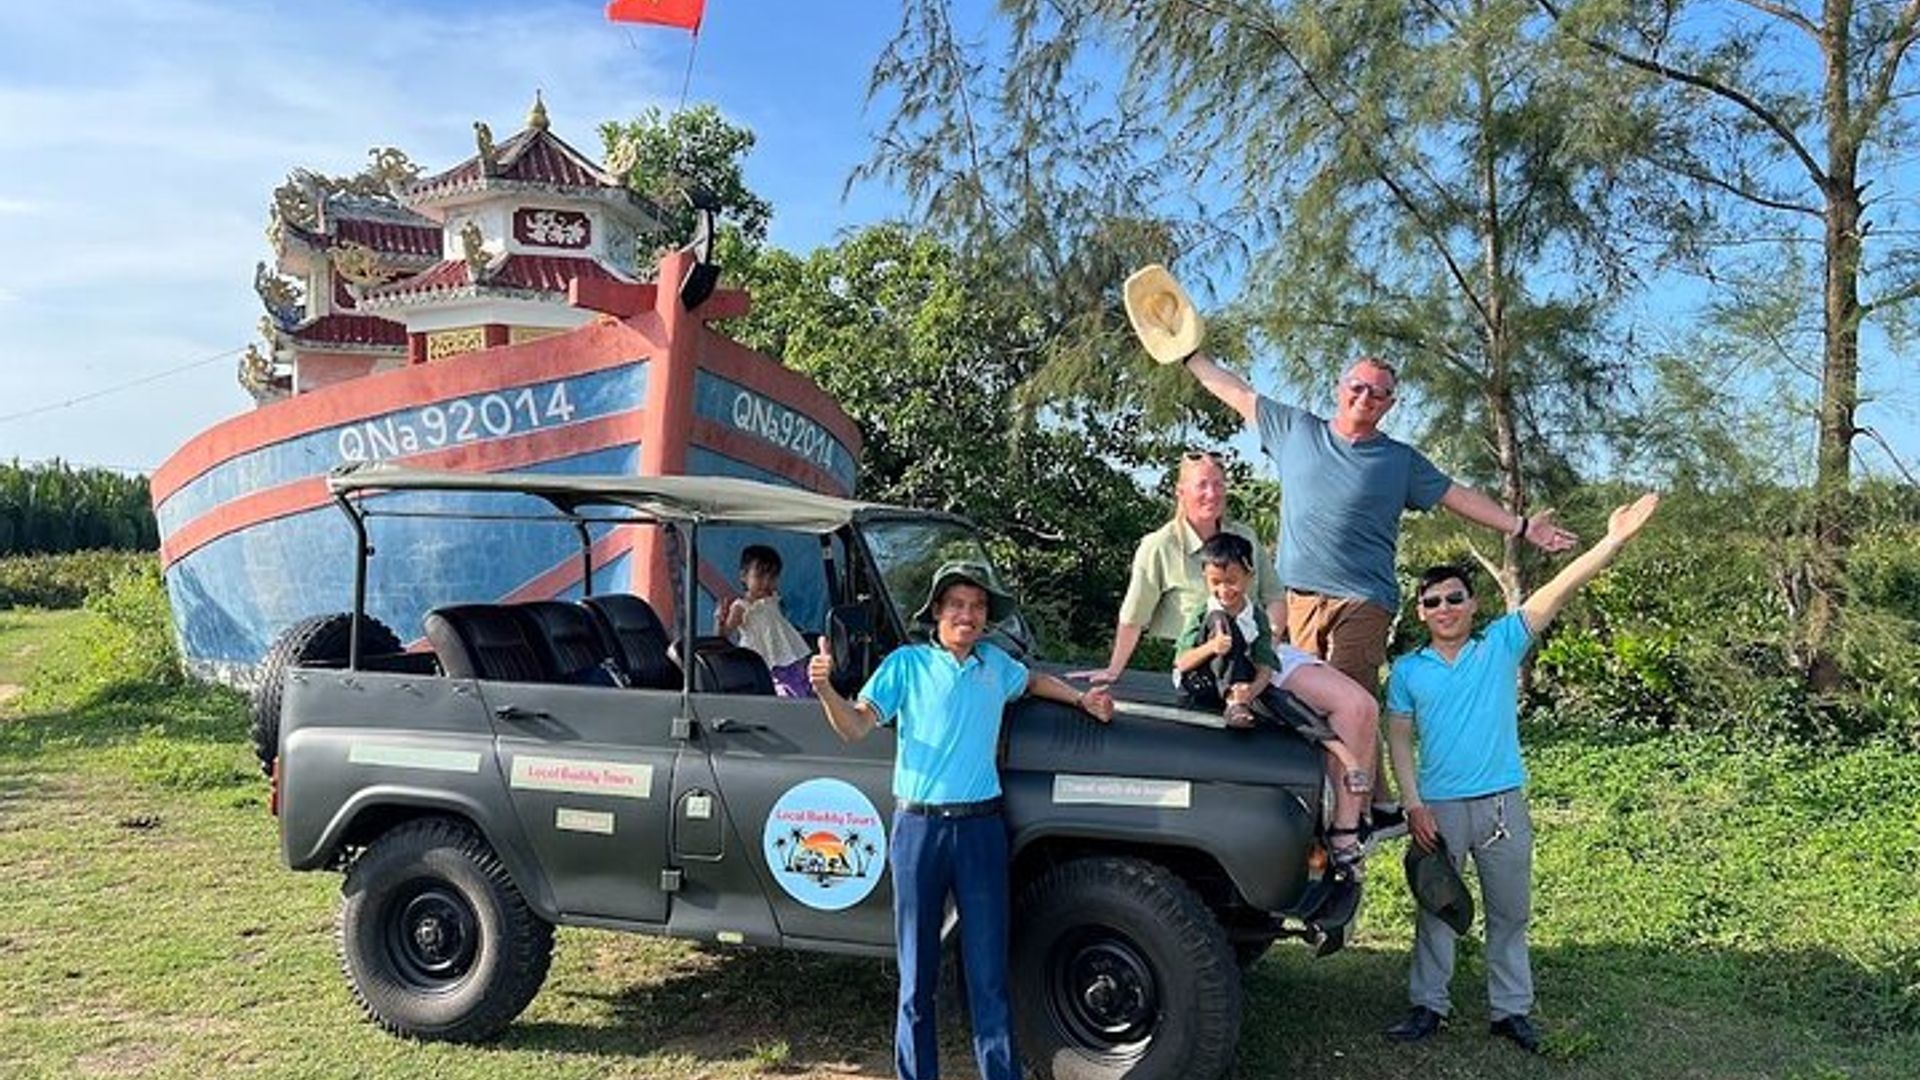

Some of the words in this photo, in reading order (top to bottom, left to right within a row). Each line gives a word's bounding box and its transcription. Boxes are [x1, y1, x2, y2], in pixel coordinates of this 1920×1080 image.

[528, 764, 559, 781] Local
[561, 766, 600, 784] Buddy
[603, 769, 635, 785] Tours
[776, 810, 805, 822] Local
[806, 810, 844, 825] Buddy
[845, 812, 877, 826] Tours
